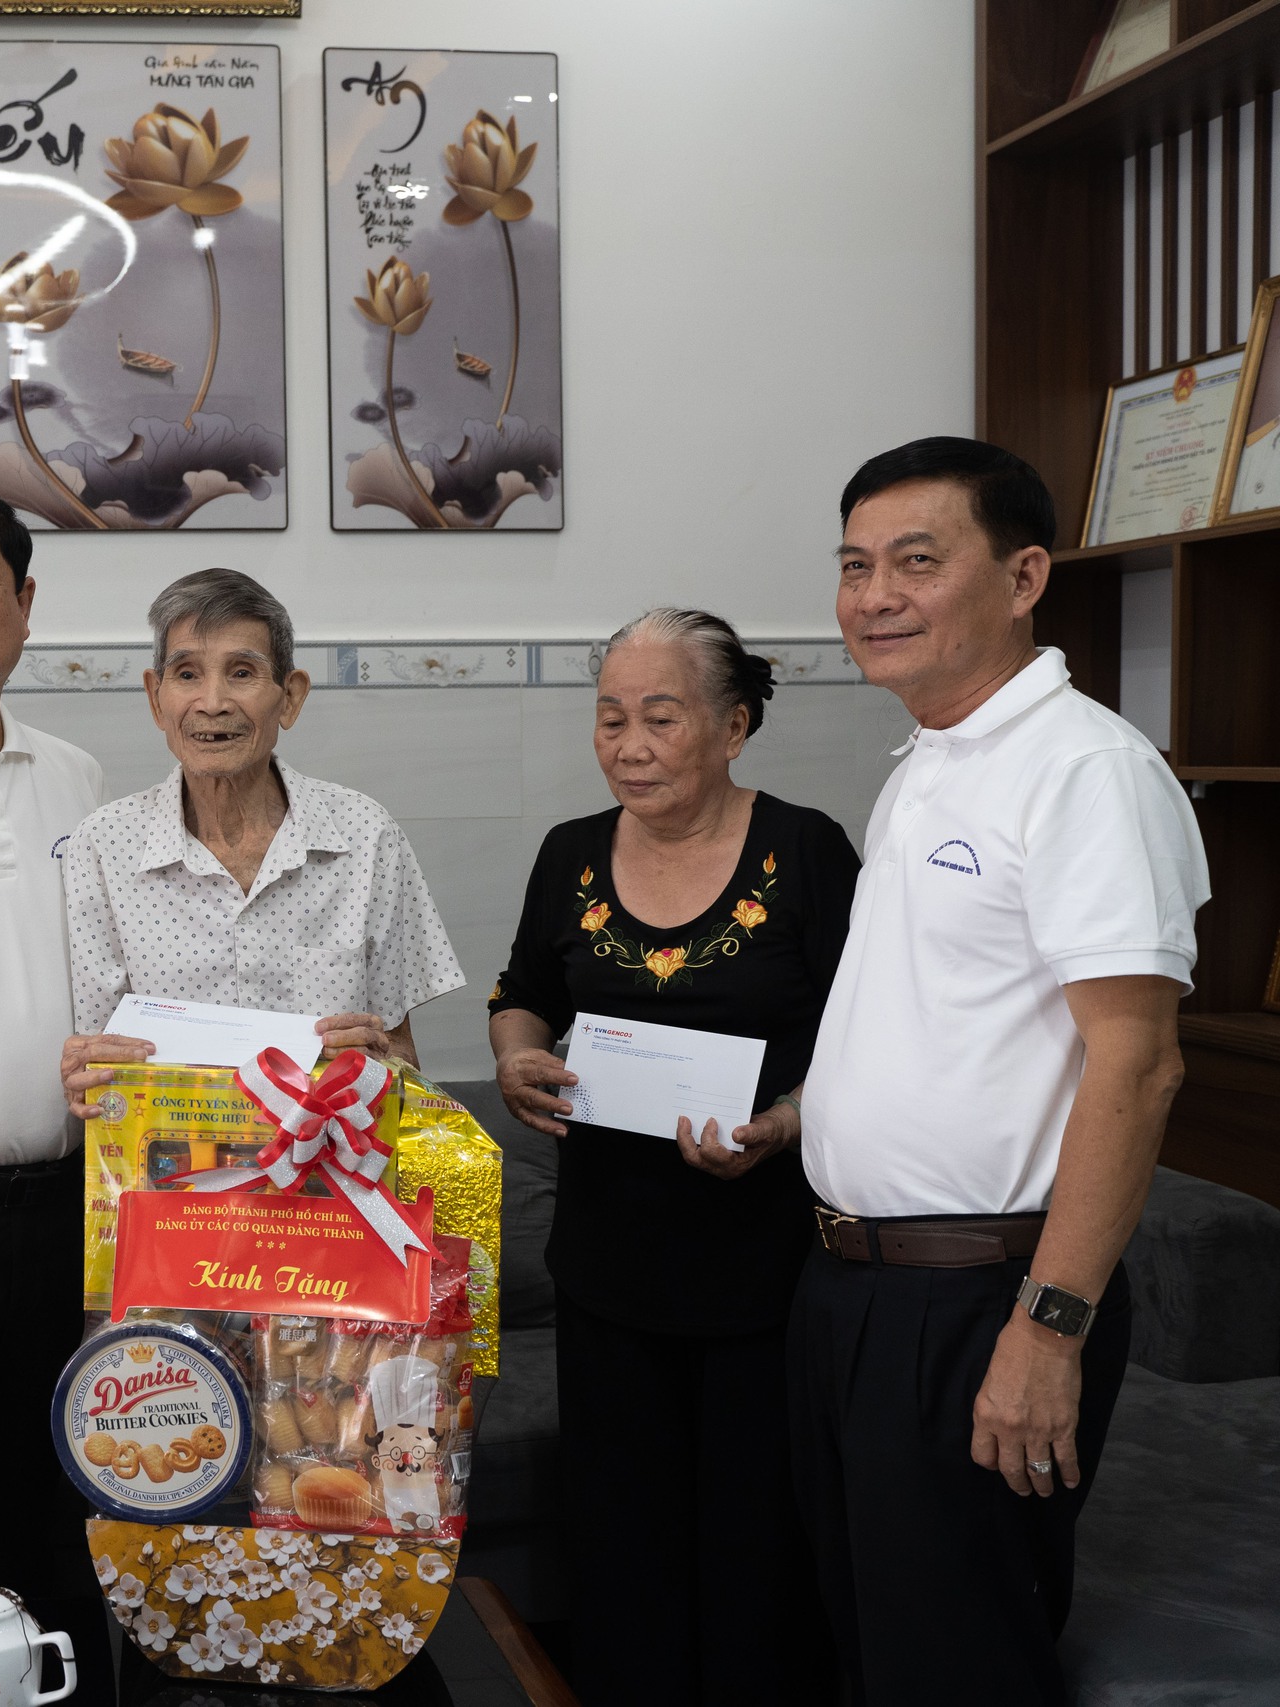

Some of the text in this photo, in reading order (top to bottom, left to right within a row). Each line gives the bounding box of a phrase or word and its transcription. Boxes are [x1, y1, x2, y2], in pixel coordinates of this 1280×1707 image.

[228, 76, 254, 88] GIA
[144, 1002, 186, 1011] EVNGENCO3
[594, 1027, 633, 1038] EVNGENCO3
[152, 1094, 254, 1110] CÔNG TY YẾN SÀO
[169, 1110, 250, 1126] THƯƠNG HIỆU
[100, 1142, 124, 1158] YẾN
[183, 1204, 212, 1215] ĐẢNG
[214, 1204, 229, 1217] BỘ
[230, 1206, 269, 1217] THÀNH
[271, 1208, 293, 1220] PHỐ
[296, 1208, 312, 1220] HỒ
[314, 1210, 334, 1222] CHÍ
[155, 1218, 364, 1240] ĐẢNG ỦY CÁC CƠ QUAN ĐẢNG THÀNH
[188, 1260, 349, 1302] Kính Tặng
[278, 1328, 317, 1342] 雅思嘉
[89, 1361, 197, 1416] Danisa
[168, 1348, 231, 1420] COPENHAGEN DENMARK
[142, 1402, 201, 1414] TRADITIONAL
[95, 1412, 208, 1432] BUTTER COOKIES
[102, 1476, 132, 1498] ORIGINAL
[132, 1490, 158, 1501] DANISH
[158, 1492, 182, 1502] RECIPE
[184, 1478, 206, 1495] NETTO
